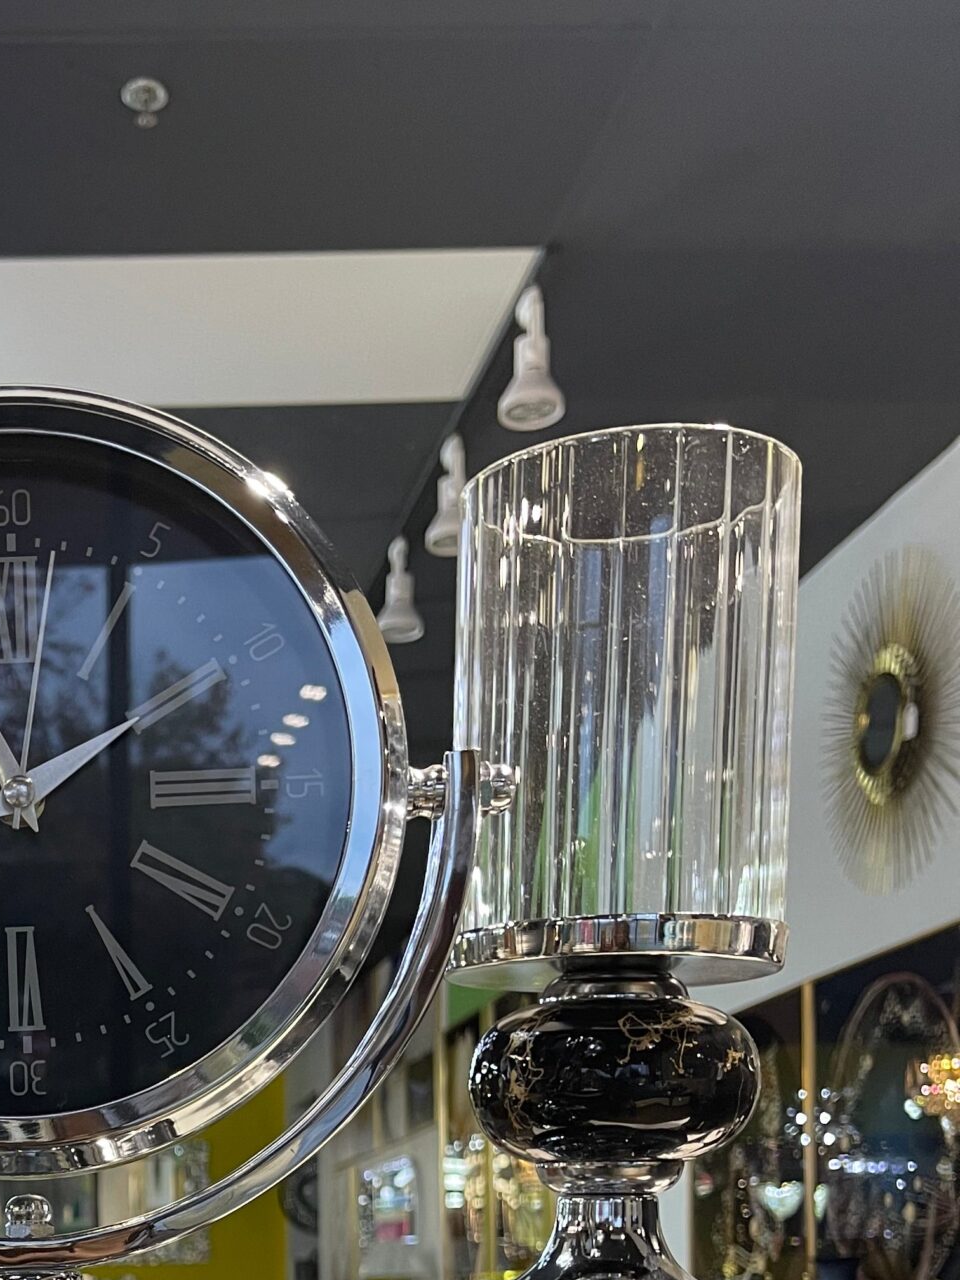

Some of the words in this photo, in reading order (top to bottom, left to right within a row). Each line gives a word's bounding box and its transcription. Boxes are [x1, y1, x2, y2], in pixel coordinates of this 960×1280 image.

[140, 522, 171, 558] 5
[244, 622, 285, 662] 10
[286, 768, 324, 797] 15
[246, 902, 292, 949] 20
[145, 1011, 189, 1058] 25
[9, 1060, 47, 1096] 30
